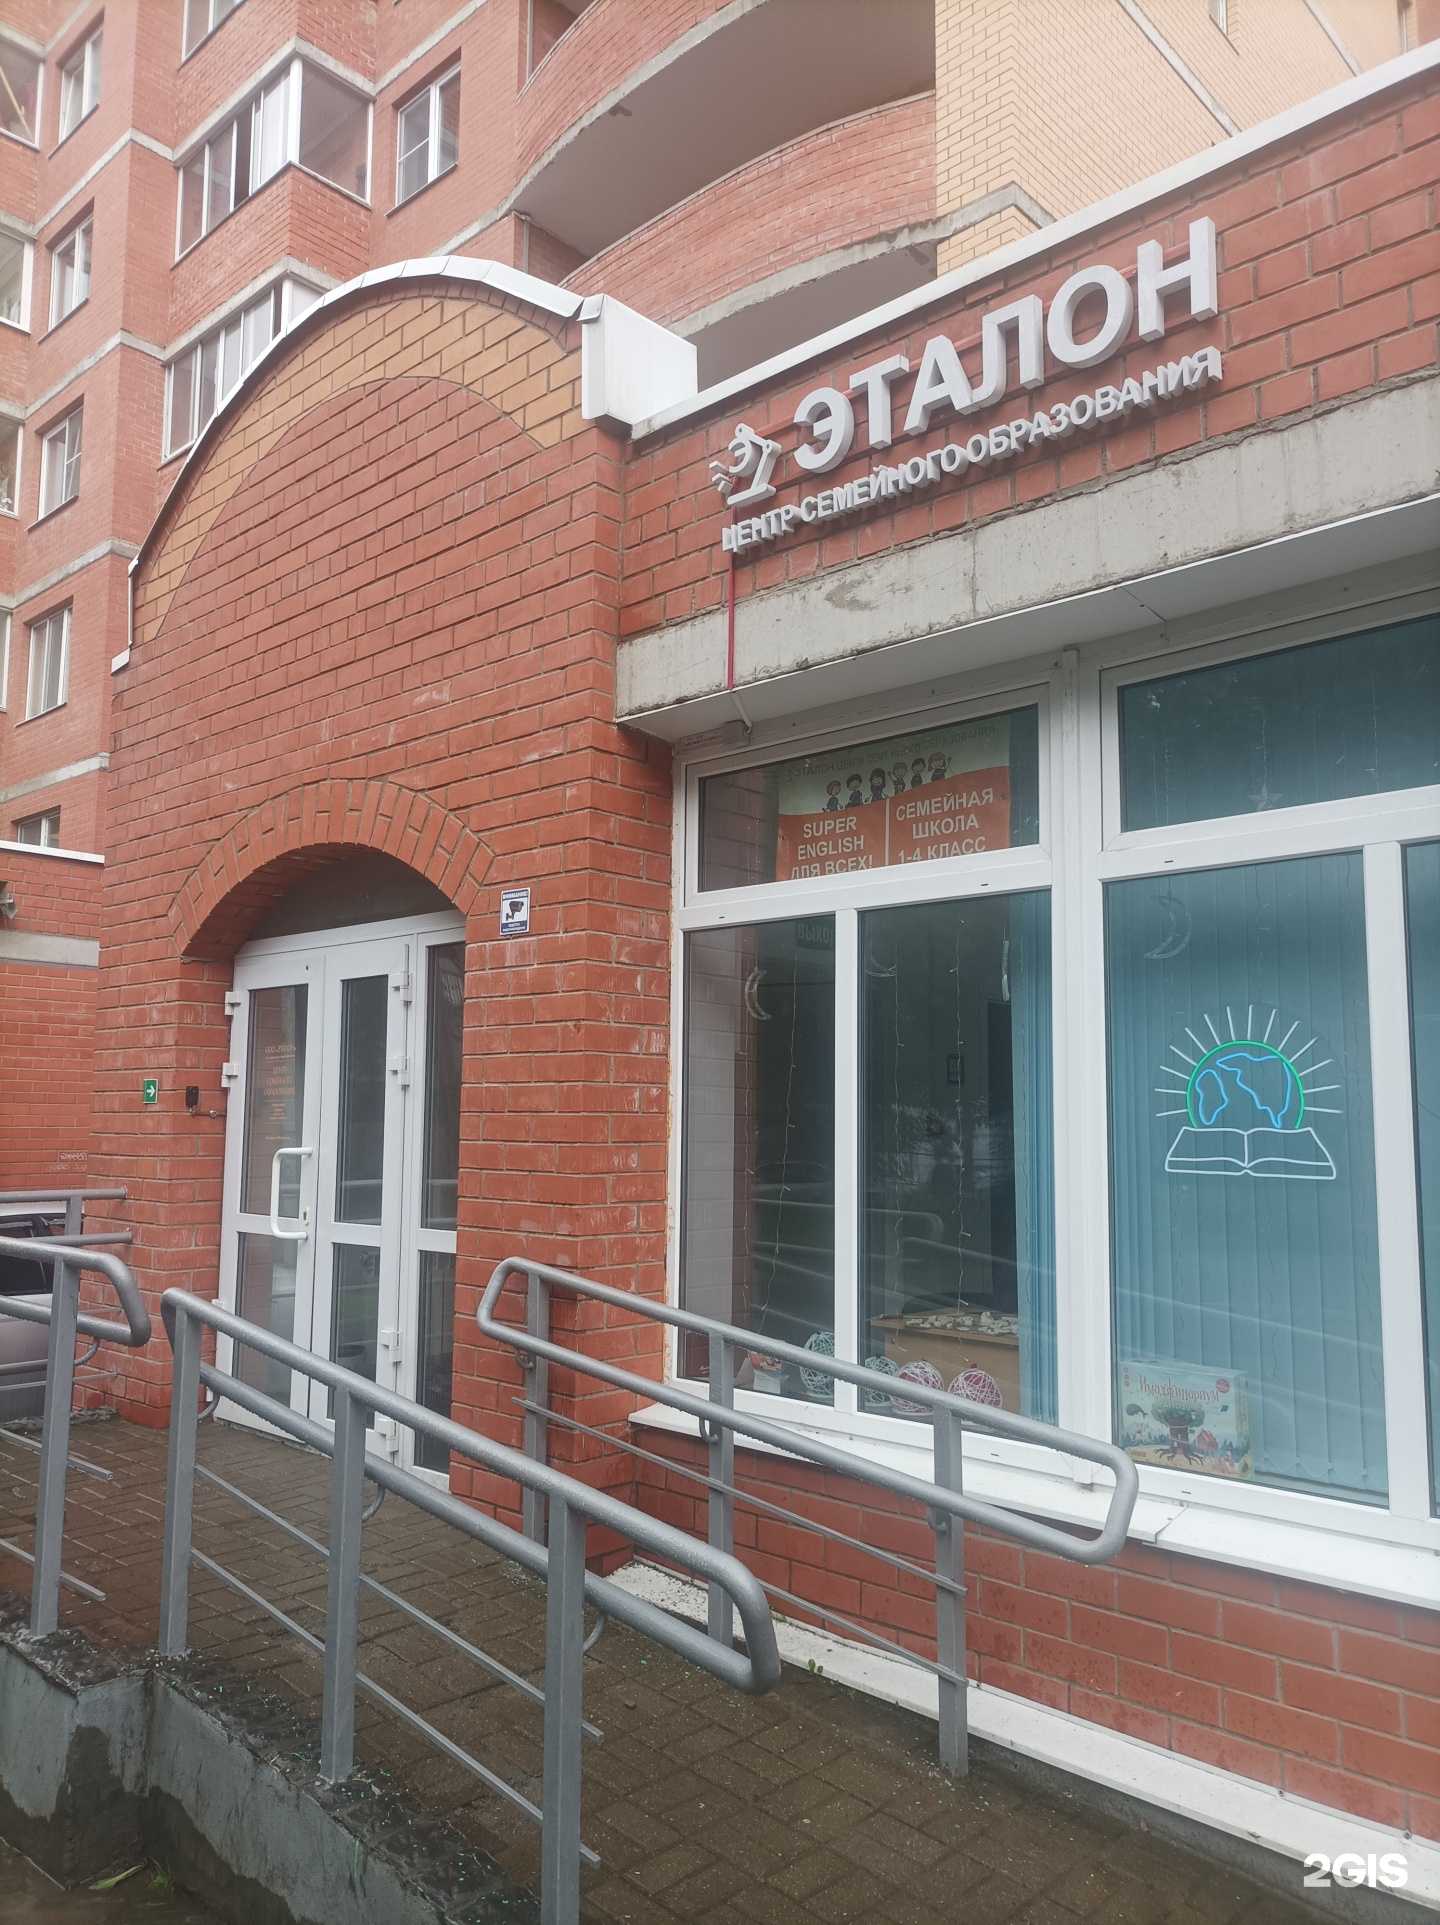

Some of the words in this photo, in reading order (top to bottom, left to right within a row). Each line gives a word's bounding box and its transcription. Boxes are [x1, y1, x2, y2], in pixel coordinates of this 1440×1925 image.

[793, 216, 1219, 474] ЭТАЛОН
[721, 504, 799, 554] ЦЕНТР
[800, 443, 968, 524] СЕМЕЙНОГО
[967, 346, 1223, 466] ОБРАЗОВАНИЯ
[896, 788, 994, 821] СЕМЕЙНАЯ
[803, 816, 857, 838] SUPER
[912, 814, 979, 840] ШКОЛА
[798, 835, 865, 860] ENGLISH
[898, 848, 922, 864] 1-4
[928, 836, 986, 860] КЛАСС
[796, 922, 833, 945] ВЫХО
